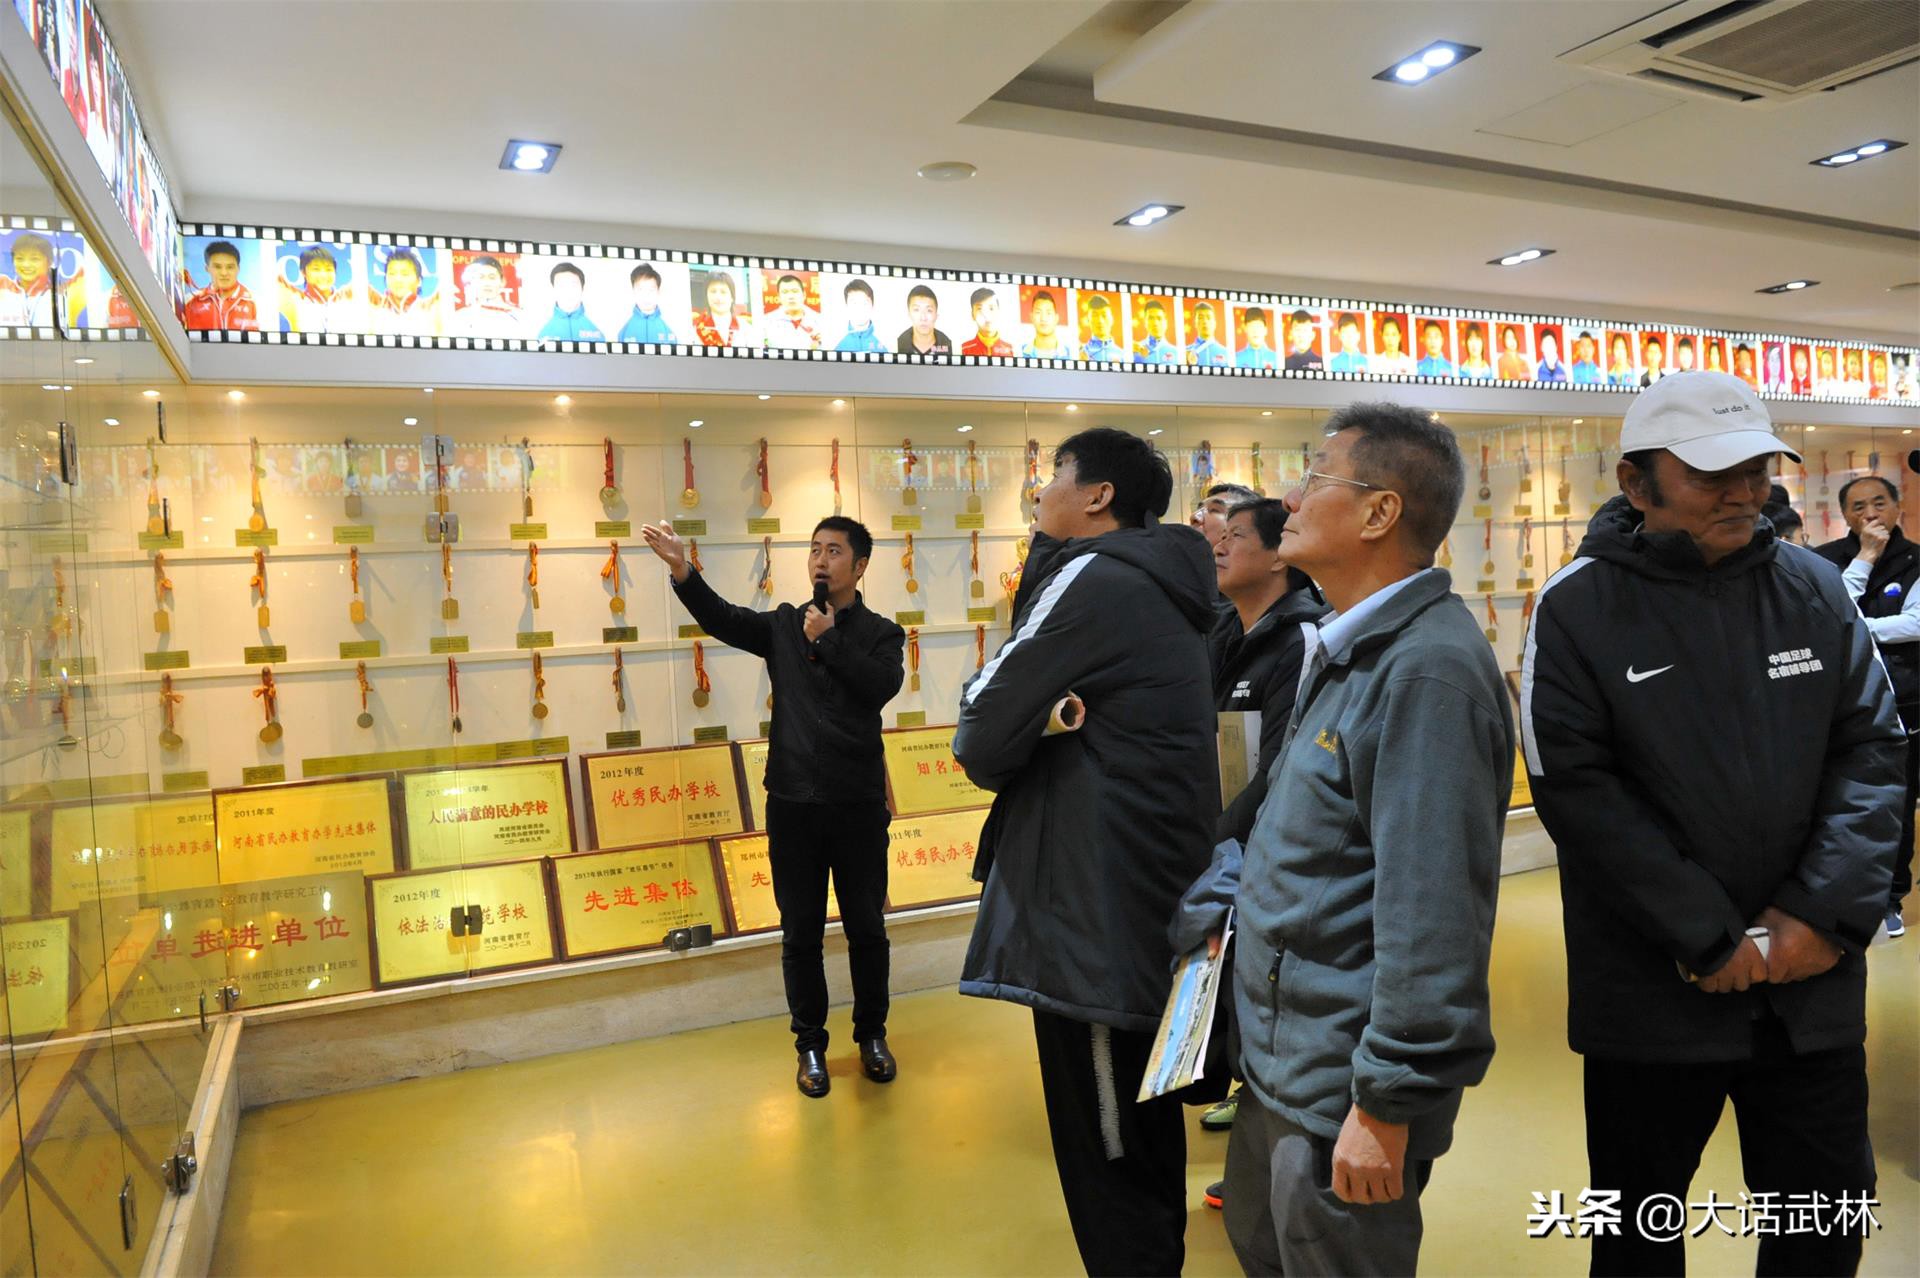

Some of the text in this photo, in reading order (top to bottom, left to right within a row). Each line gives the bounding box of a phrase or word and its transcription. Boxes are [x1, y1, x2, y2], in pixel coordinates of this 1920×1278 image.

[1768, 648, 1813, 666] 中国足球
[600, 766, 644, 779] 2012年度
[611, 780, 721, 808] 优秀民办学校
[233, 807, 275, 818] 2011年度
[429, 800, 549, 825] 人民满意的民办学校
[233, 820, 377, 849] 河南省民办教育办学先进集体
[393, 888, 441, 903] 2012年度
[584, 878, 698, 912] 先进集体
[398, 903, 529, 936] 依法治范学校
